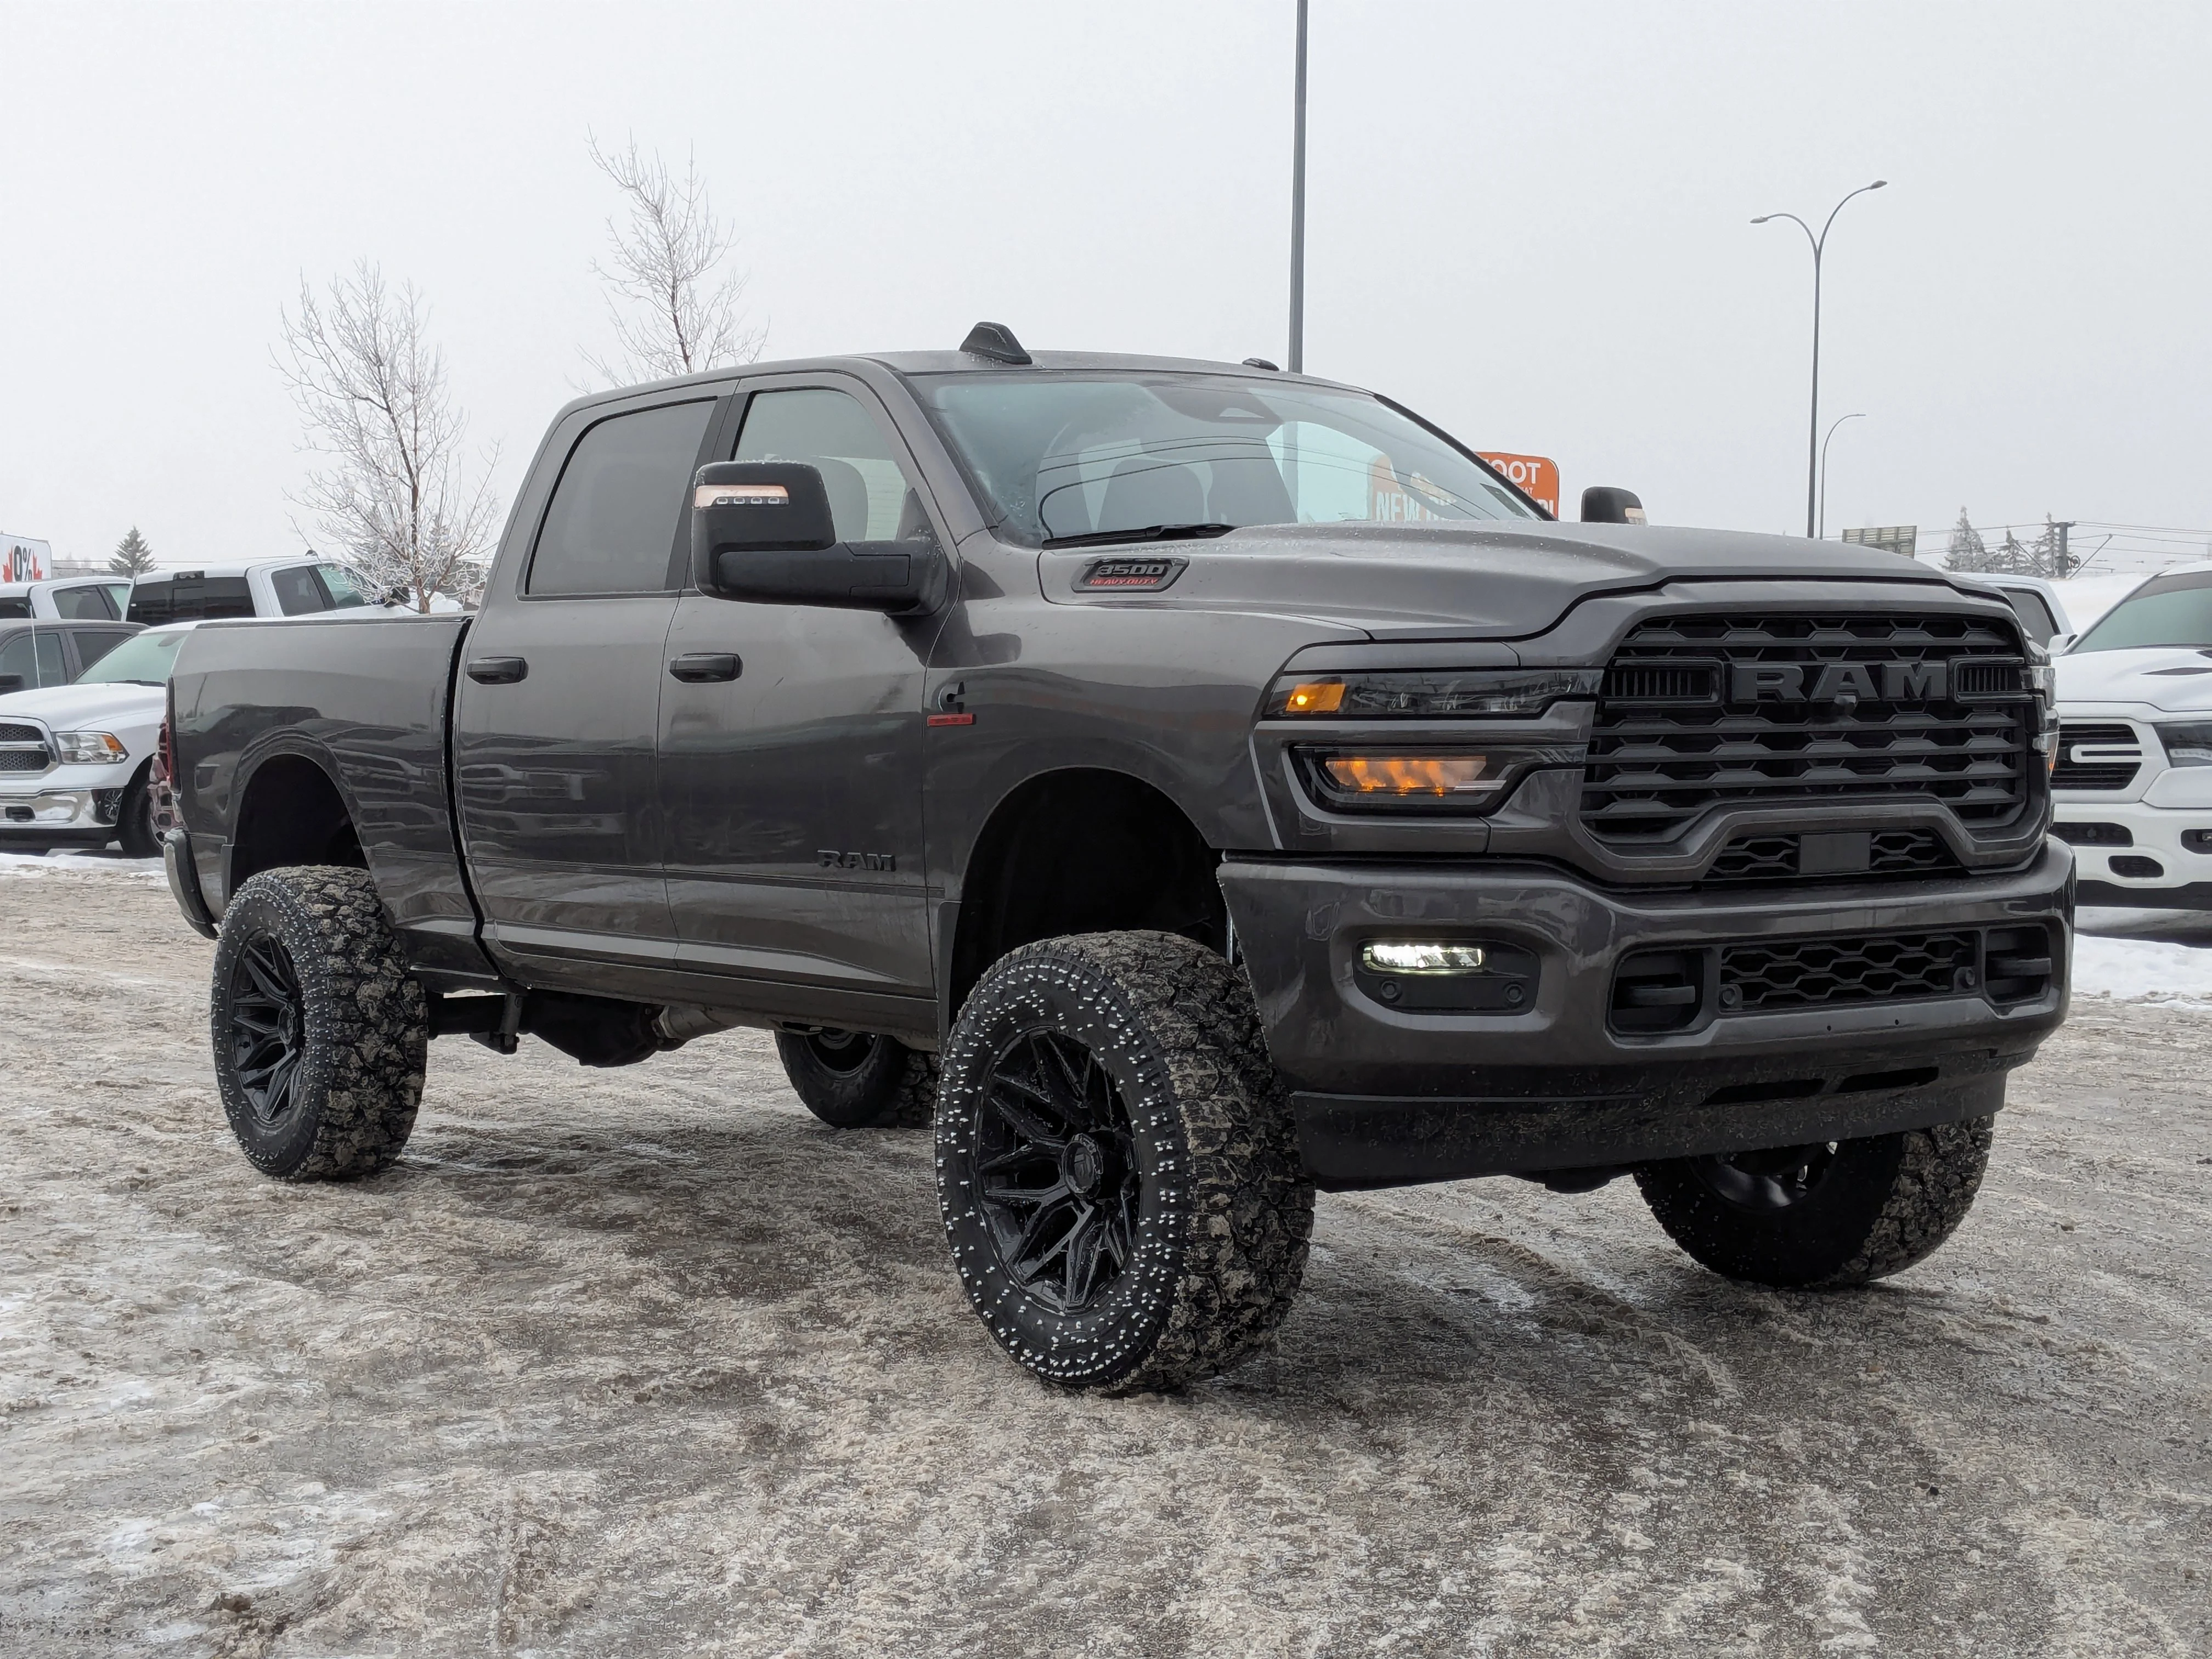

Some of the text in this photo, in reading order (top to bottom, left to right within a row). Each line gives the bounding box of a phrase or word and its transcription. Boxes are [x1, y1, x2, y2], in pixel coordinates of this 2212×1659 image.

[1096, 564, 1165, 575] 3500
[1732, 662, 1947, 702] RAM
[817, 849, 896, 871] RAM
